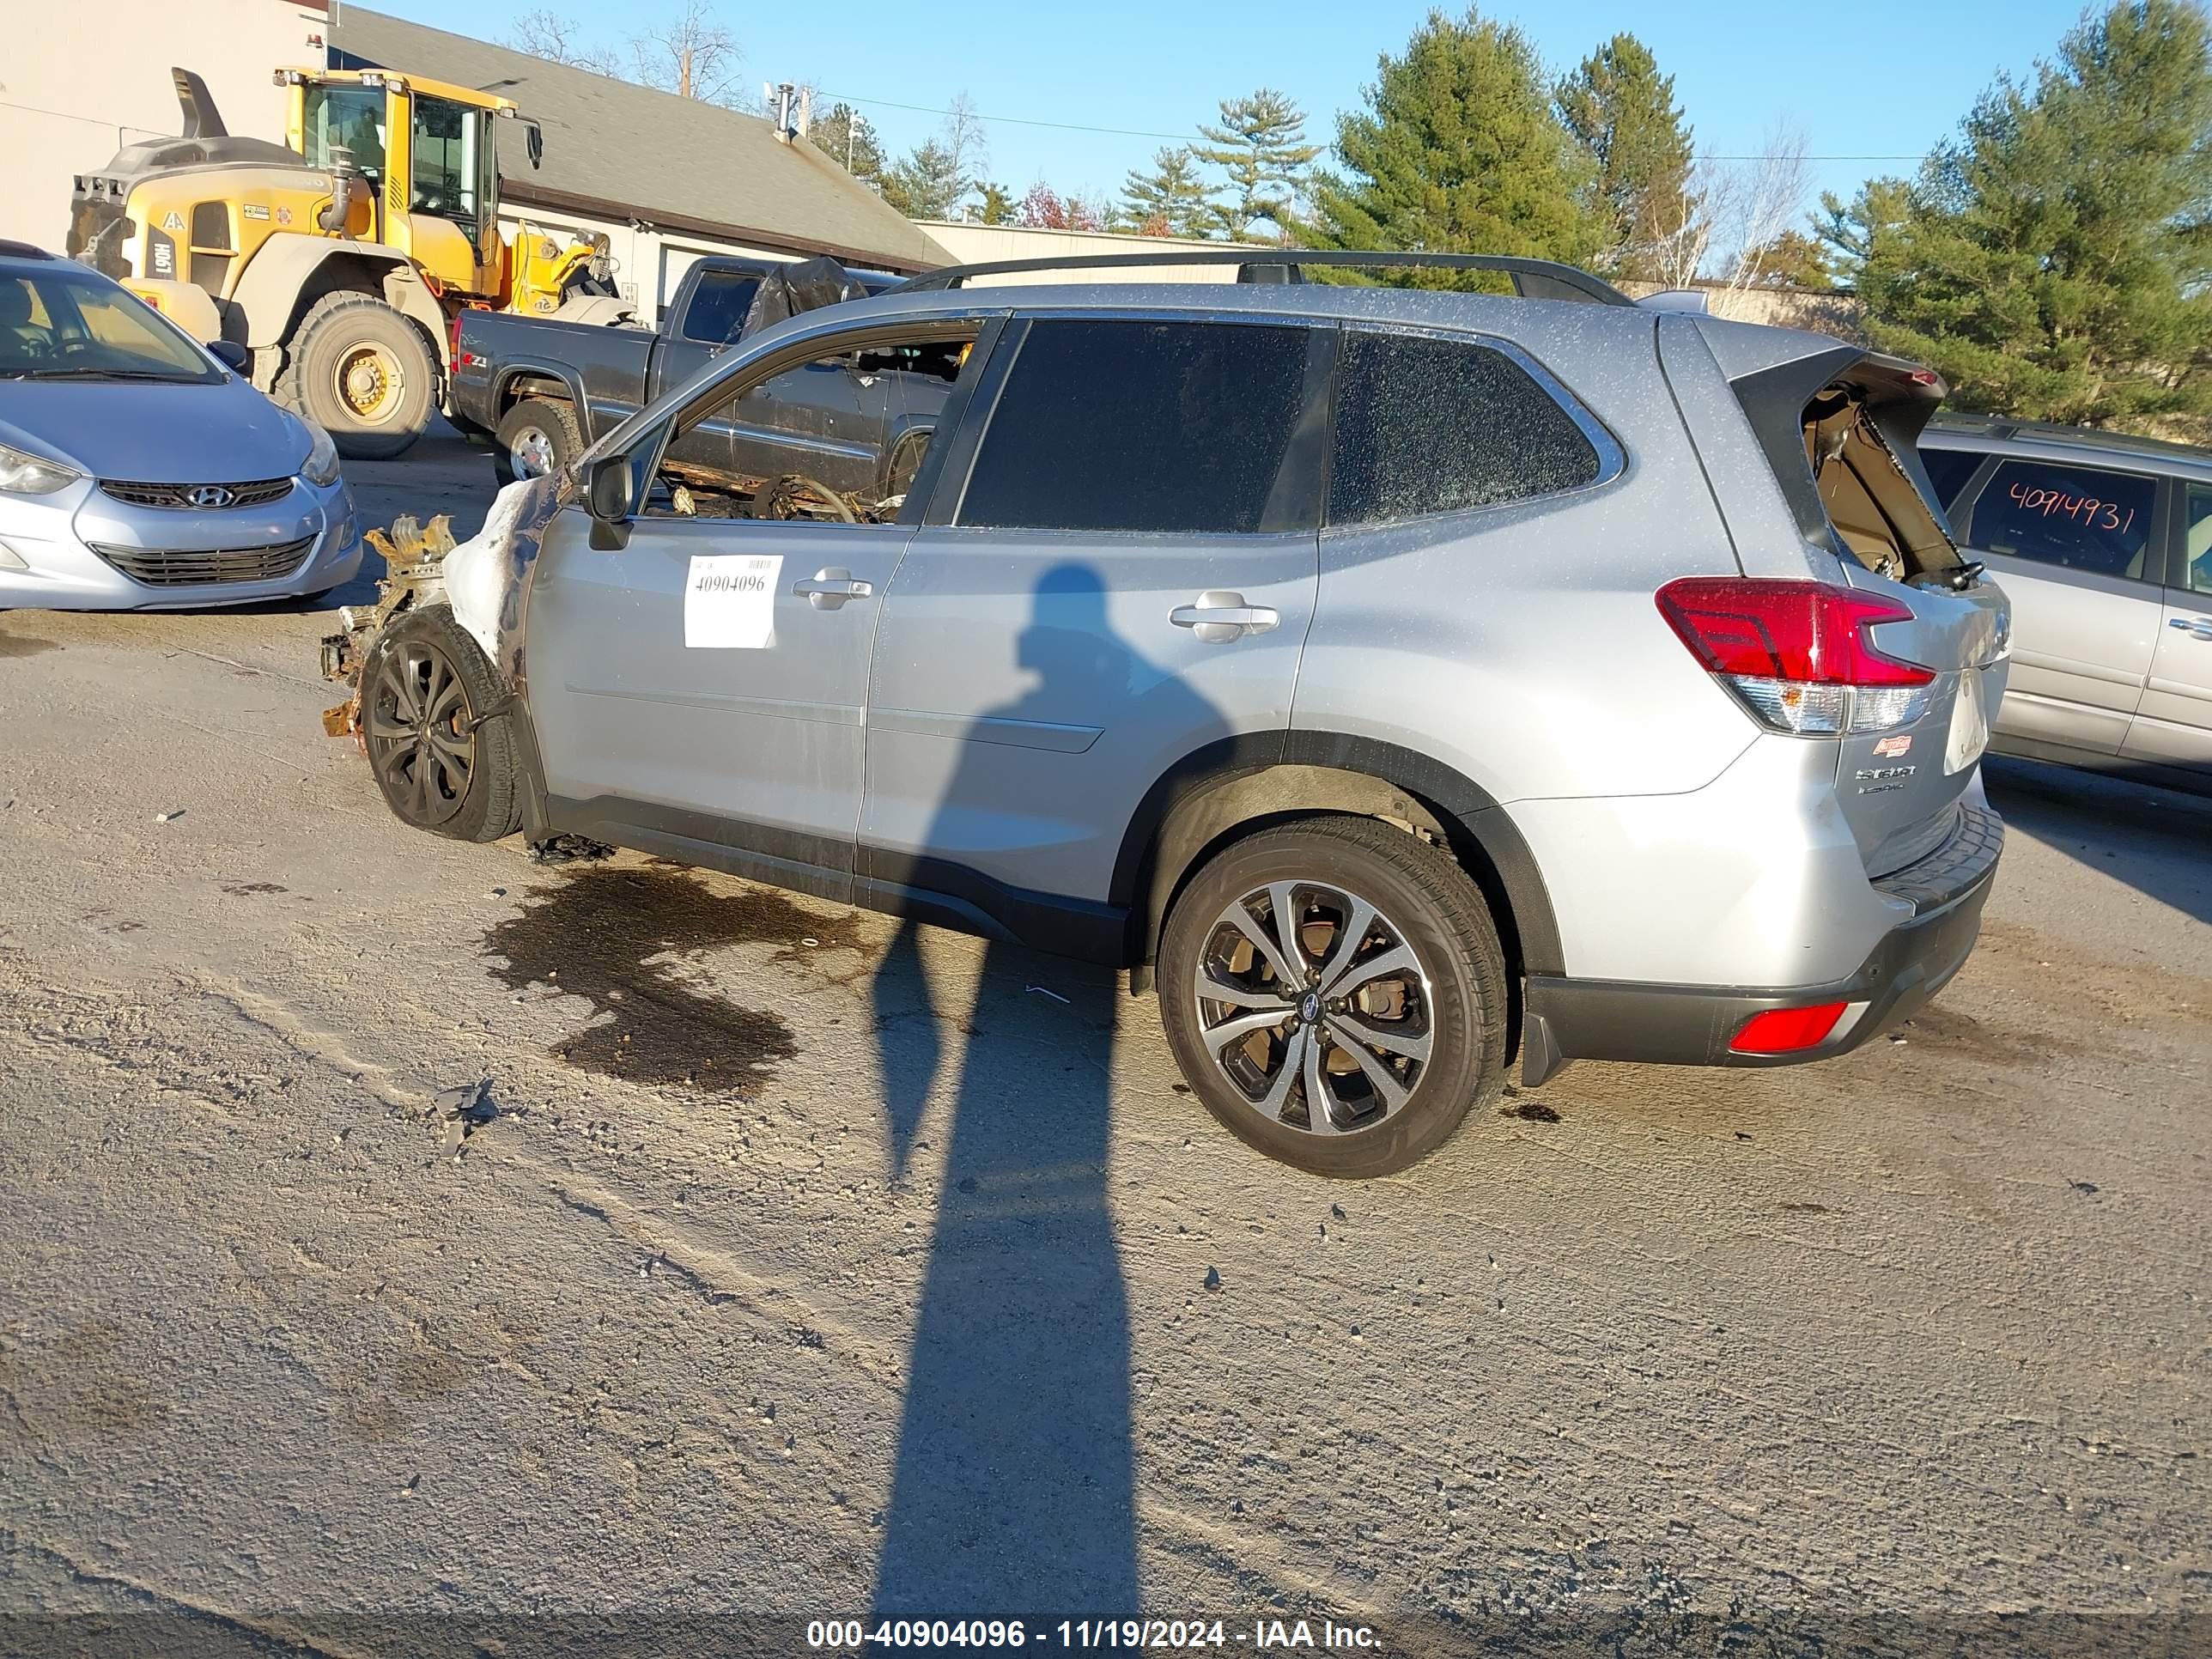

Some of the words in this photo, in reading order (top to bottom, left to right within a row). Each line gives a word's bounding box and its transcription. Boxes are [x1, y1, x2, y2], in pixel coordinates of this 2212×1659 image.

[154, 243, 172, 274] L90H
[2009, 483, 2135, 535] 40914931
[696, 575, 766, 592] 40904096
